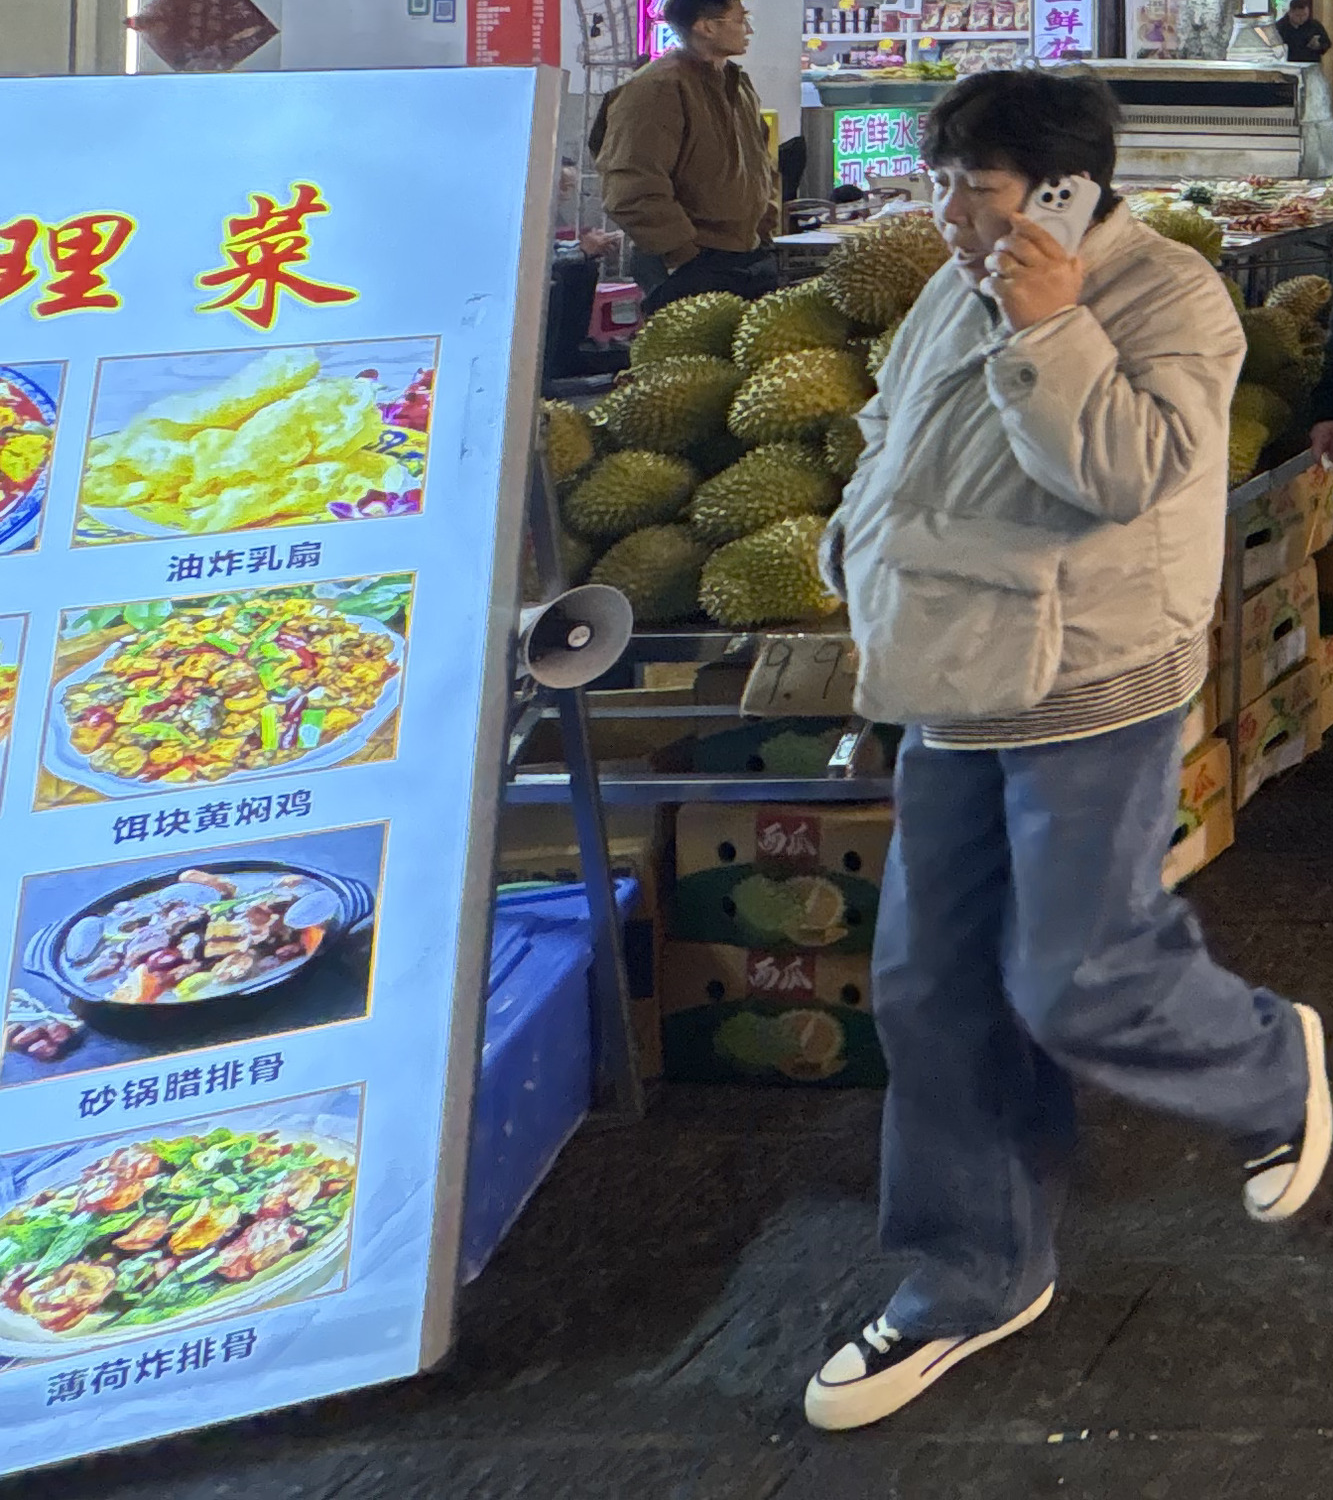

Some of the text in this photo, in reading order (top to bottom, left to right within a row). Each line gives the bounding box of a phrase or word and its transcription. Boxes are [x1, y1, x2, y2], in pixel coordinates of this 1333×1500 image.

[0, 181, 360, 330] 理菜
[166, 541, 323, 584] 油炸乳扇
[766, 640, 844, 706] 9.9
[112, 788, 313, 846] 饵块黄焖鸡
[77, 1051, 286, 1121] 砂锅腊排骨
[45, 1327, 258, 1407] 薄荷炸排骨
